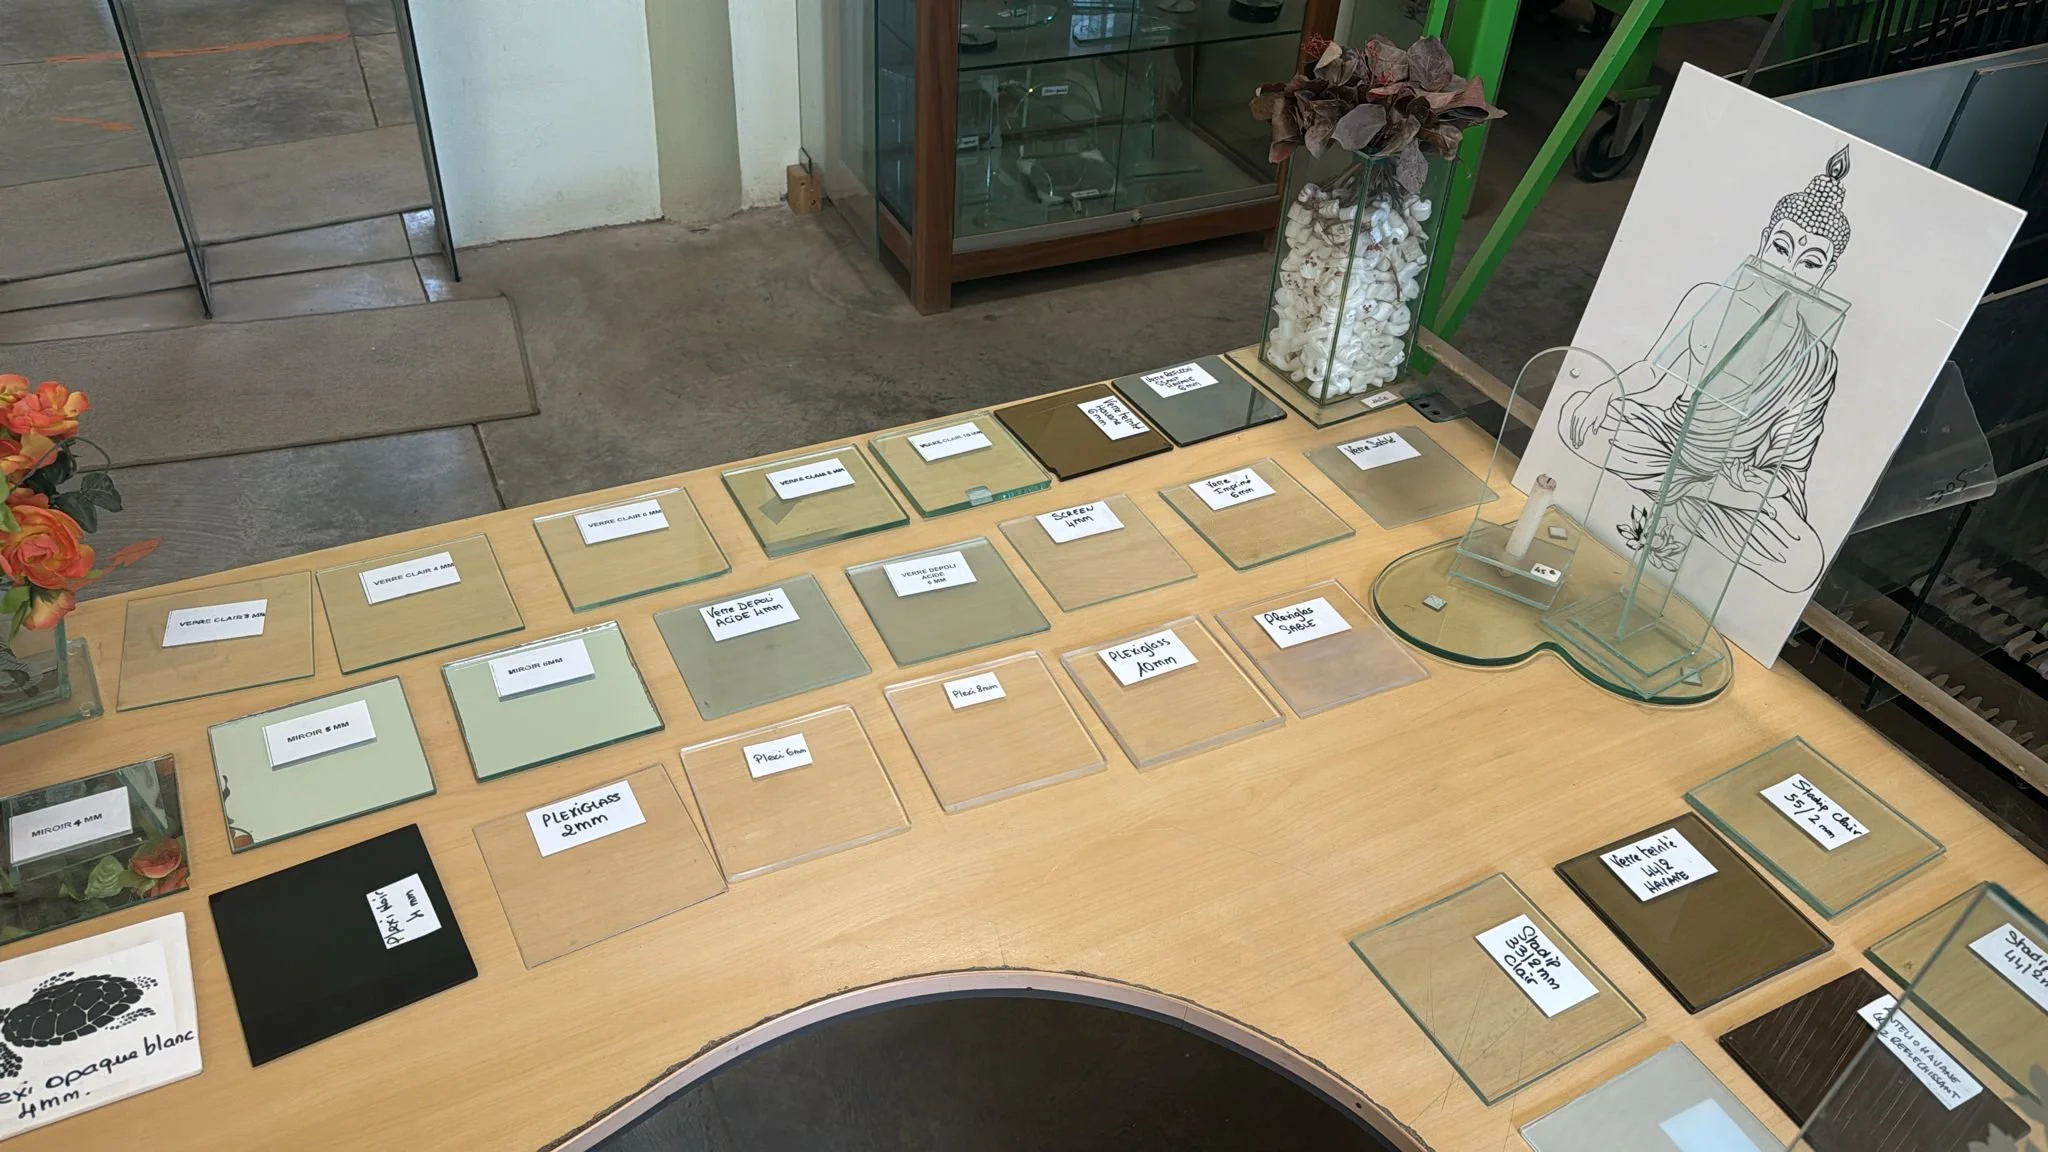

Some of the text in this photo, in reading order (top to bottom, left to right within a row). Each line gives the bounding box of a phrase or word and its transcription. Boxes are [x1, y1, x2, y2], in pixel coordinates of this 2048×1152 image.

[942, 435, 962, 443] CLAIR
[1344, 445, 1371, 456] Verre
[780, 477, 804, 485] VERRE
[805, 472, 827, 480] CLAIR
[1206, 479, 1231, 488] Verre
[588, 518, 615, 528] VERRE
[617, 513, 641, 523] CLAIR
[373, 574, 404, 586] VERRE
[405, 568, 432, 579] CLAIR
[440, 562, 455, 570] MM
[901, 563, 956, 578] VERRE DEPOLI
[921, 571, 945, 580] ACIDE
[706, 605, 734, 619] Verre
[179, 618, 212, 627] VERRE
[214, 614, 243, 623] CLAIR
[1278, 618, 1317, 634] SABLE
[508, 662, 541, 675] MIROIR
[1136, 655, 1177, 677] 10mm
[952, 687, 976, 699] Plexi
[287, 728, 324, 744] MIROIR
[333, 720, 350, 731] MM
[753, 748, 784, 764] Plexi
[1791, 780, 1864, 836] Stadip Clair
[31, 813, 103, 838] MIROIR 4 MM
[560, 813, 609, 838] 2mm
[1609, 852, 1642, 869] Verre
[374, 890, 405, 947] Plexi Noir
[1518, 925, 1561, 968] Stadip
[1503, 954, 1539, 985] Clair
[45, 1050, 139, 1089] opaque
[143, 1030, 195, 1056] blanc
